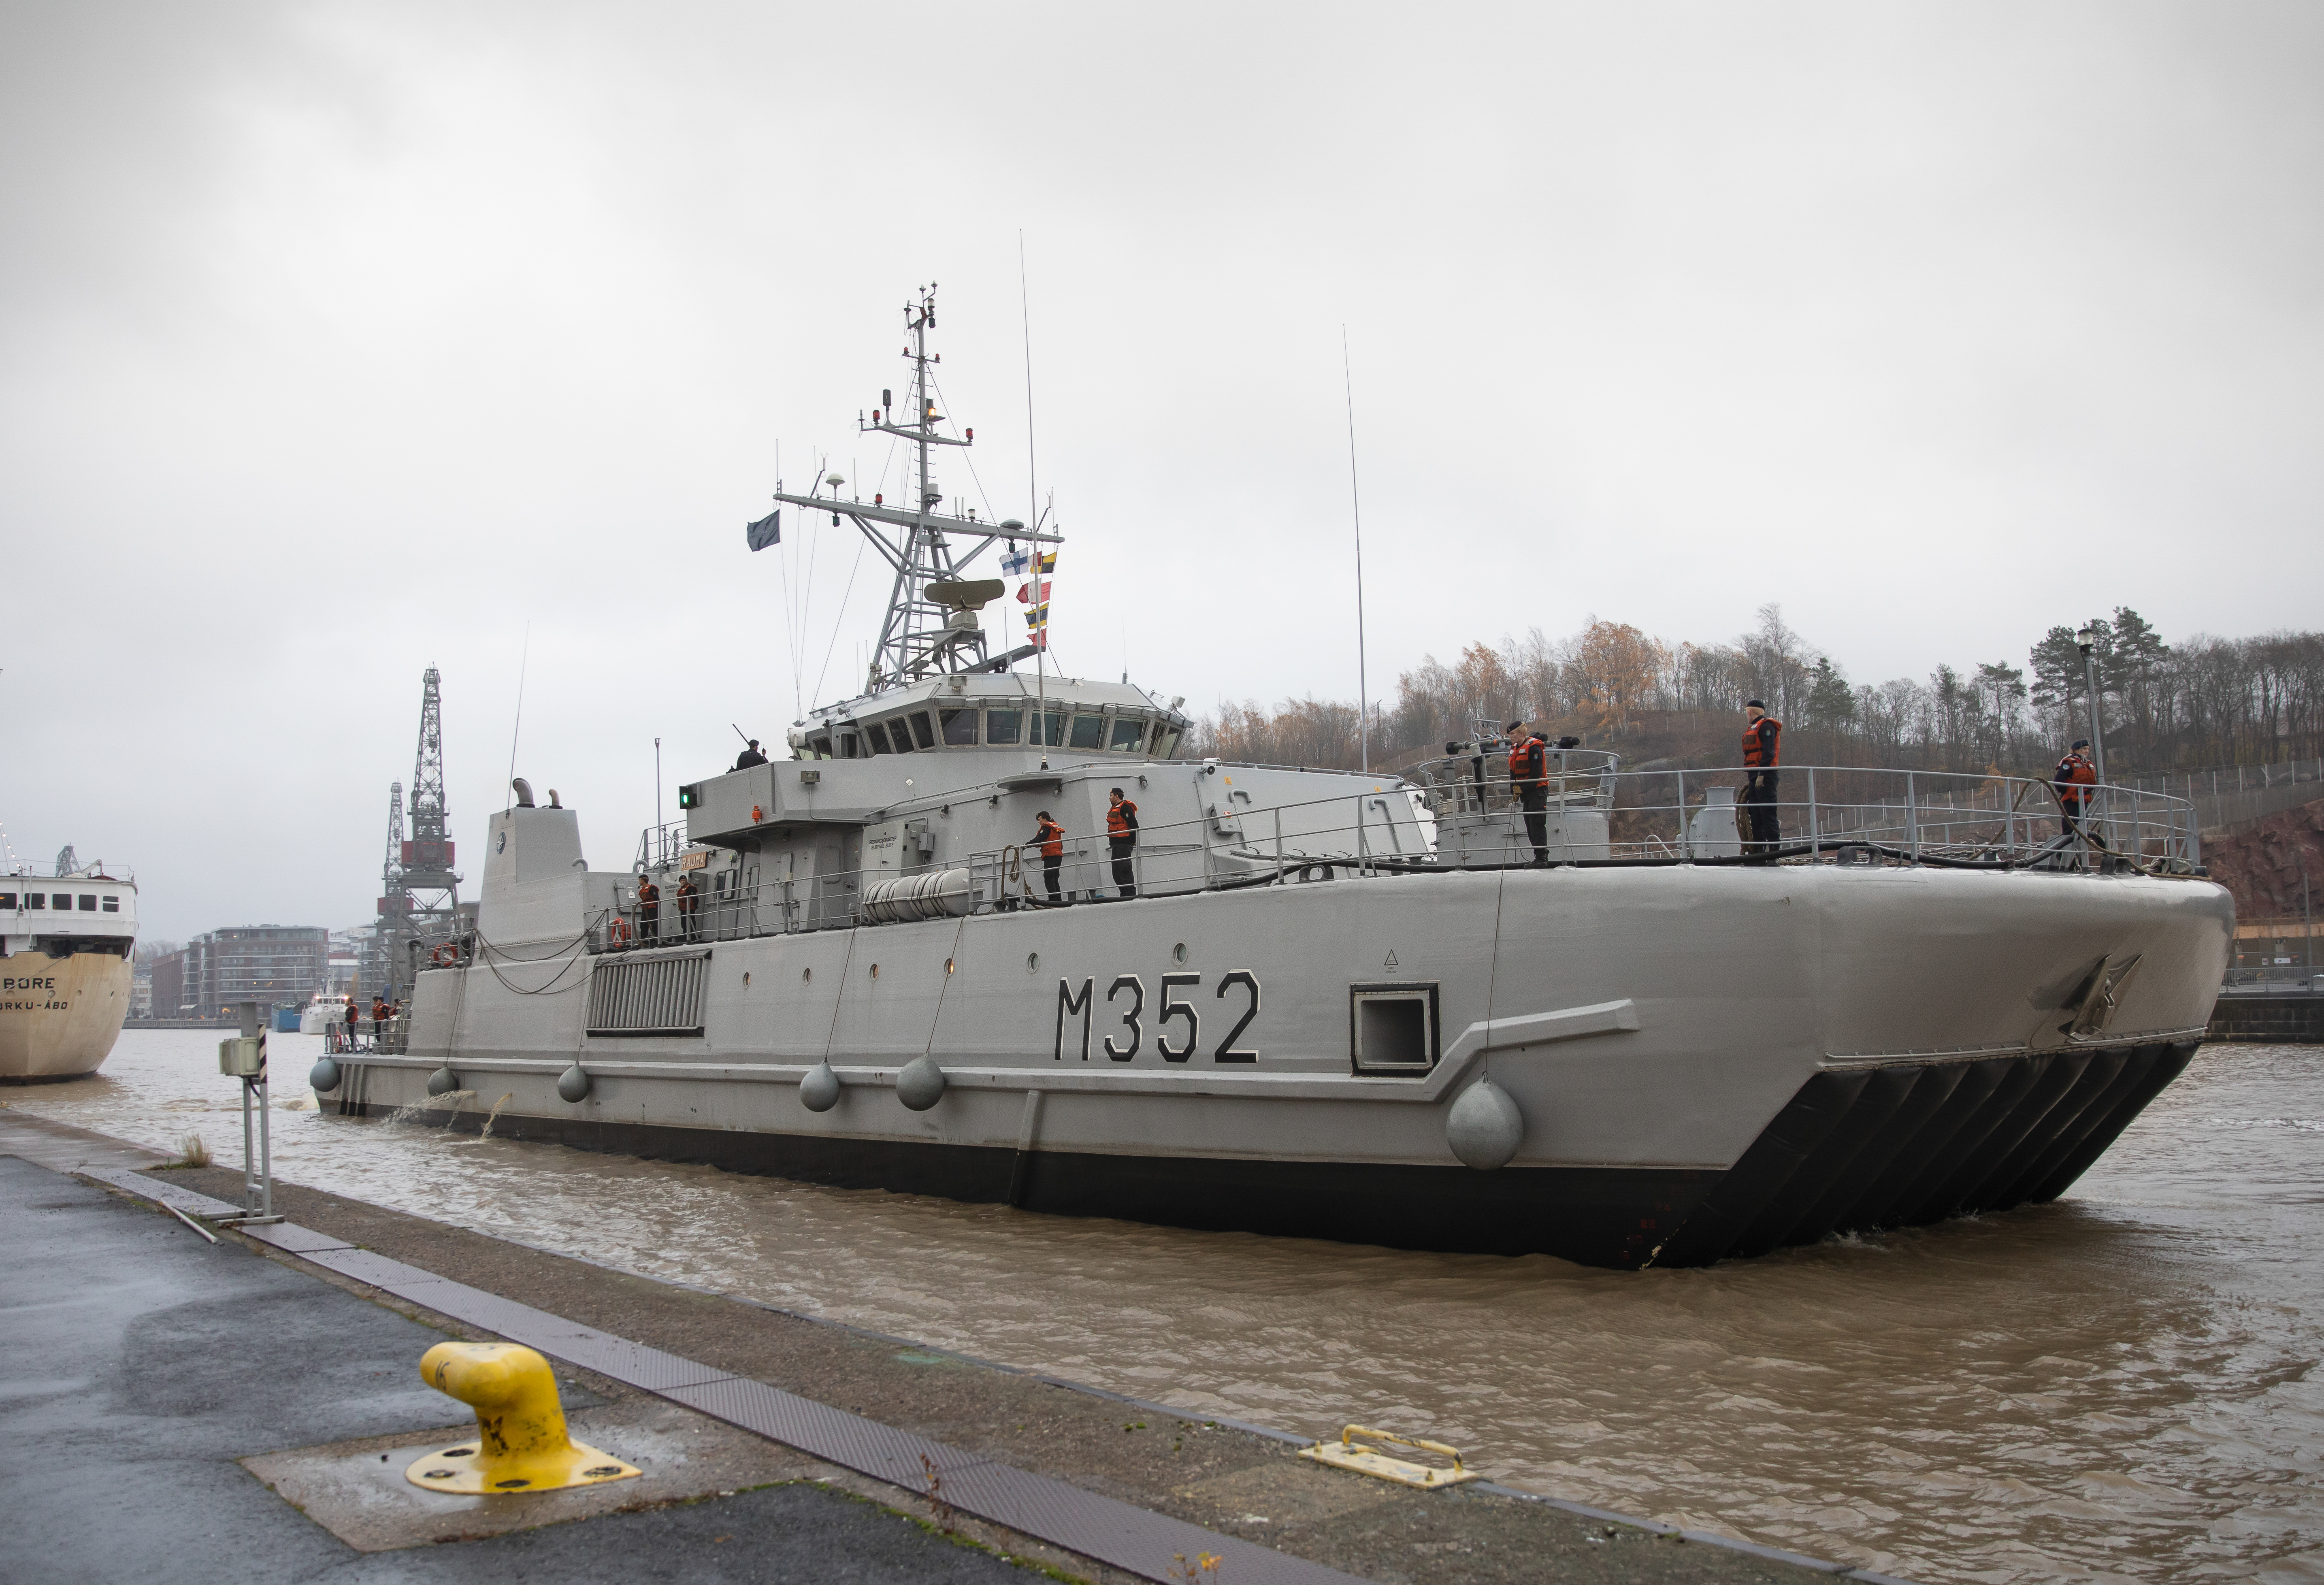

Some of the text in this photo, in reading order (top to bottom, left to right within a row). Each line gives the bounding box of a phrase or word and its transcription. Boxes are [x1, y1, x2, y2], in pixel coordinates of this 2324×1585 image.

[682, 854, 704, 869] RAUMA
[4, 978, 55, 989] BORE
[1055, 968, 1261, 1064] M352
[1640, 1219, 1656, 1229] 22
